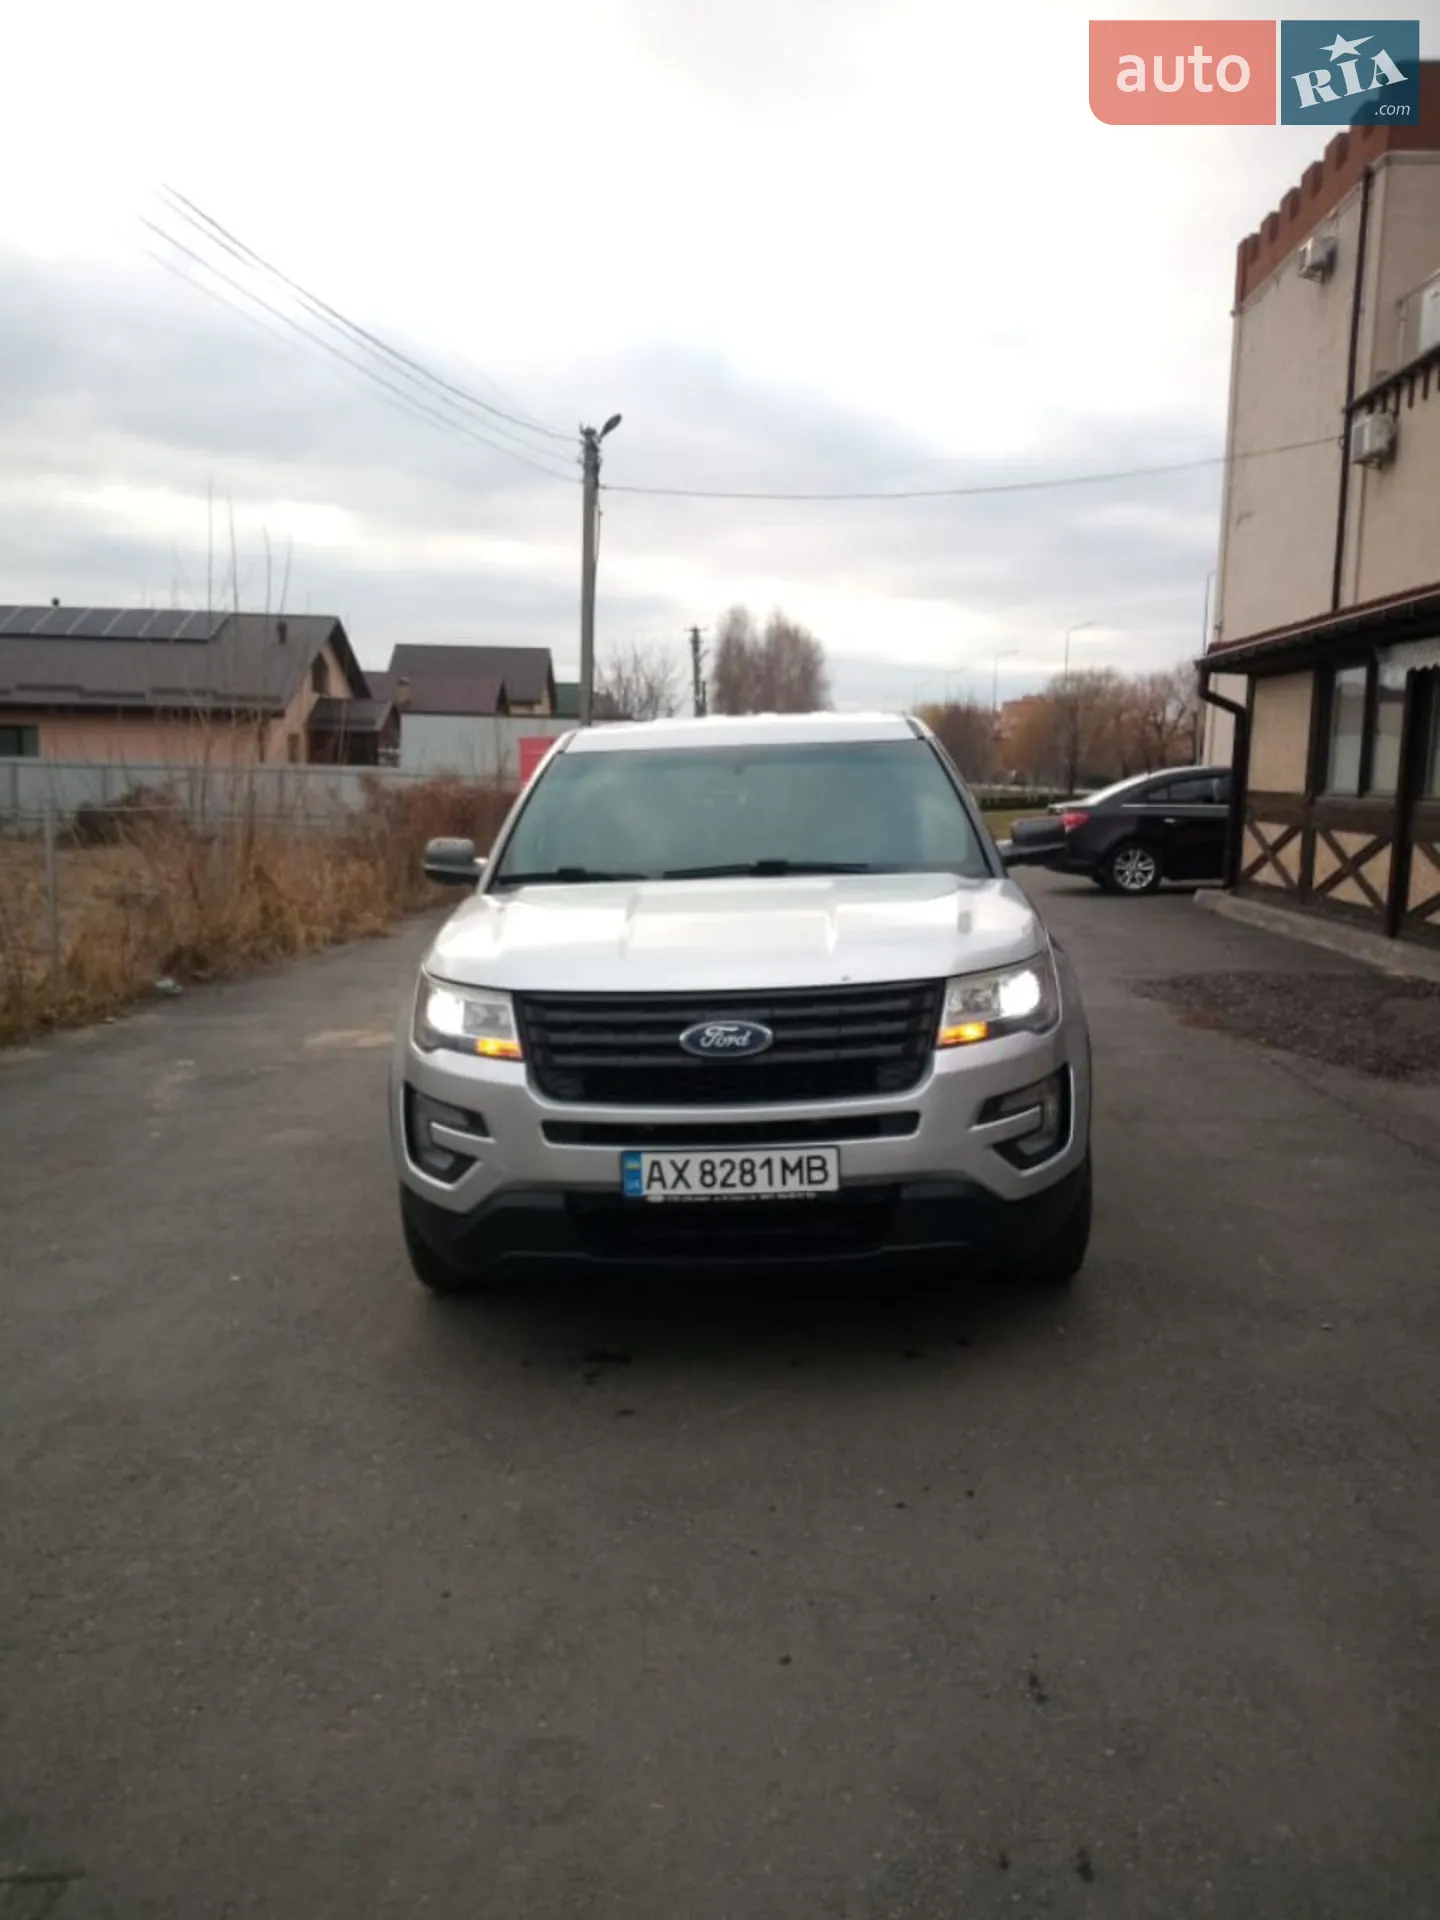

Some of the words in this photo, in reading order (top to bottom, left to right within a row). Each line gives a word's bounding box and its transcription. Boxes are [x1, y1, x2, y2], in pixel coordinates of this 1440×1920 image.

[700, 1025, 752, 1048] Ford
[646, 1159, 692, 1190] AX
[699, 1157, 774, 1188] 8281
[780, 1155, 830, 1187] MB
